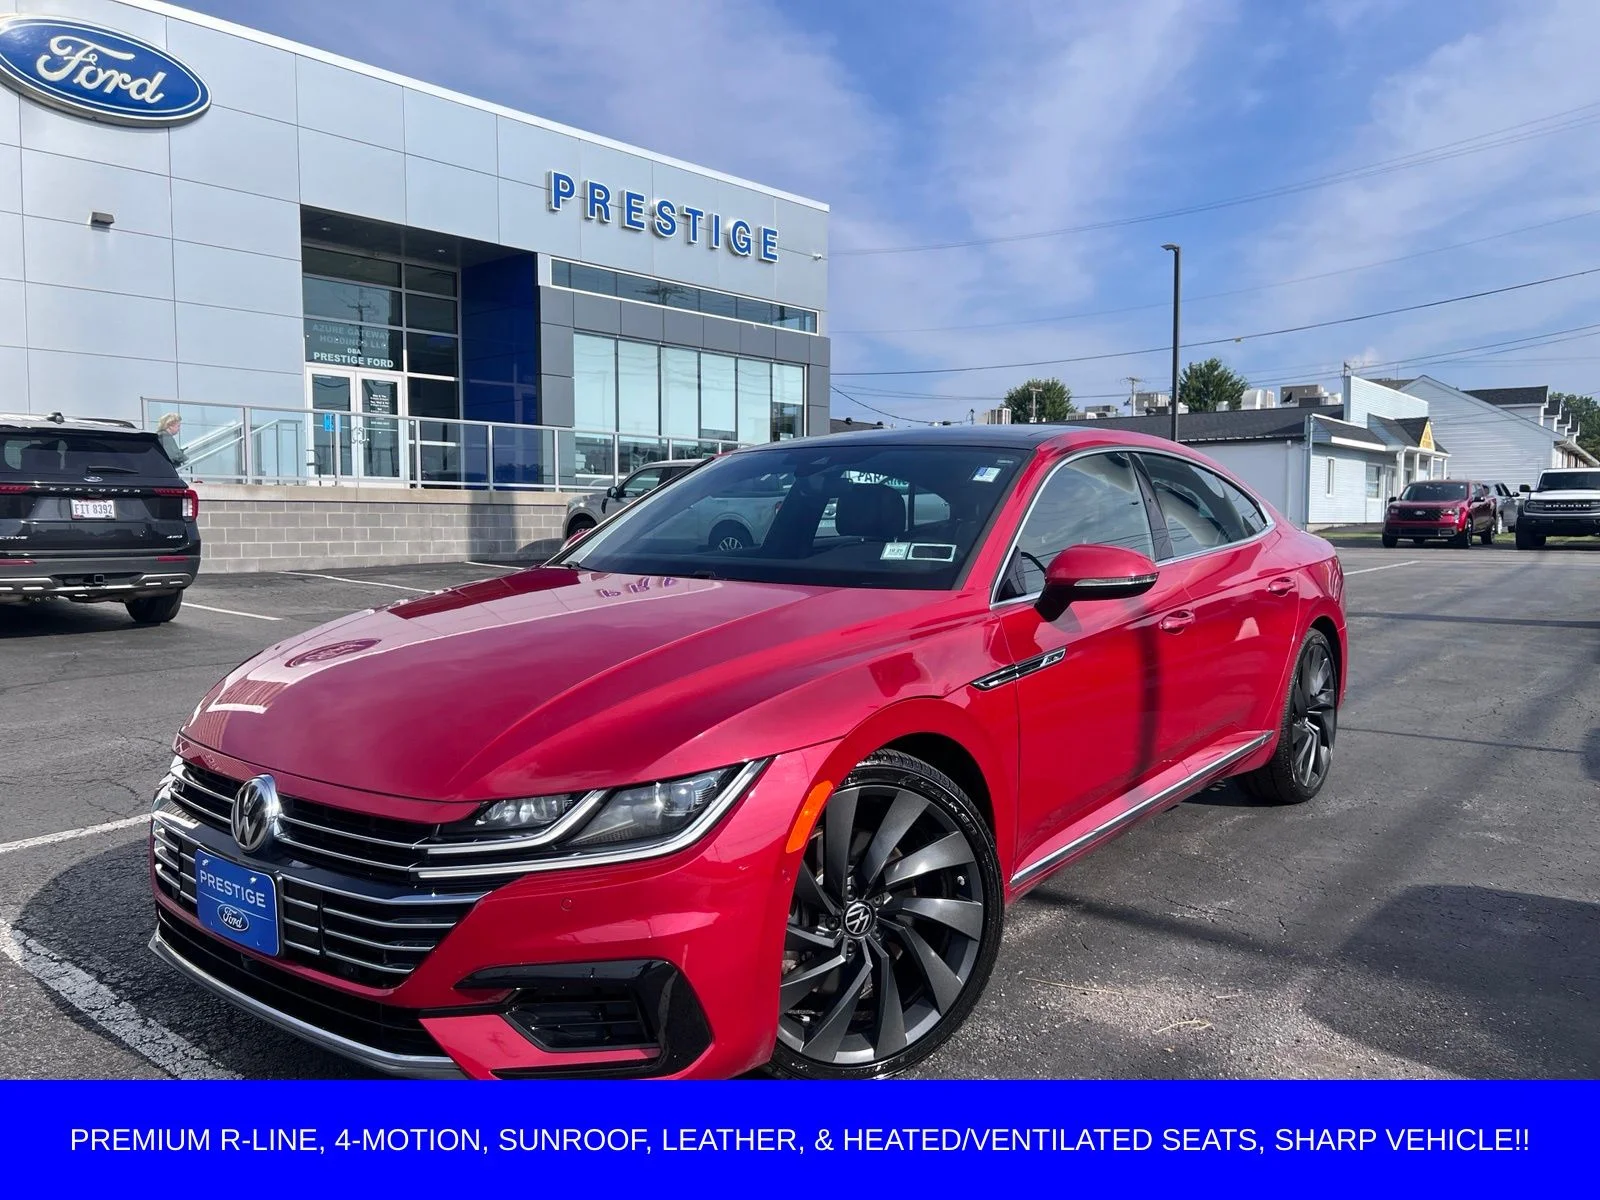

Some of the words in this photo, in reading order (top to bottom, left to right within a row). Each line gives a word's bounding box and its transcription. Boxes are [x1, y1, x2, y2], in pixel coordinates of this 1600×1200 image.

[36, 35, 167, 104] Ford
[547, 170, 779, 263] PRESTIGE
[312, 323, 345, 335] AZURE
[347, 326, 390, 341] GATEWAY
[313, 351, 365, 366] PRESTIGE
[366, 357, 394, 368] FORD
[75, 503, 90, 514] FIT
[92, 503, 113, 515] 8392
[200, 870, 267, 908] PRESTIGE
[222, 907, 243, 929] Ford
